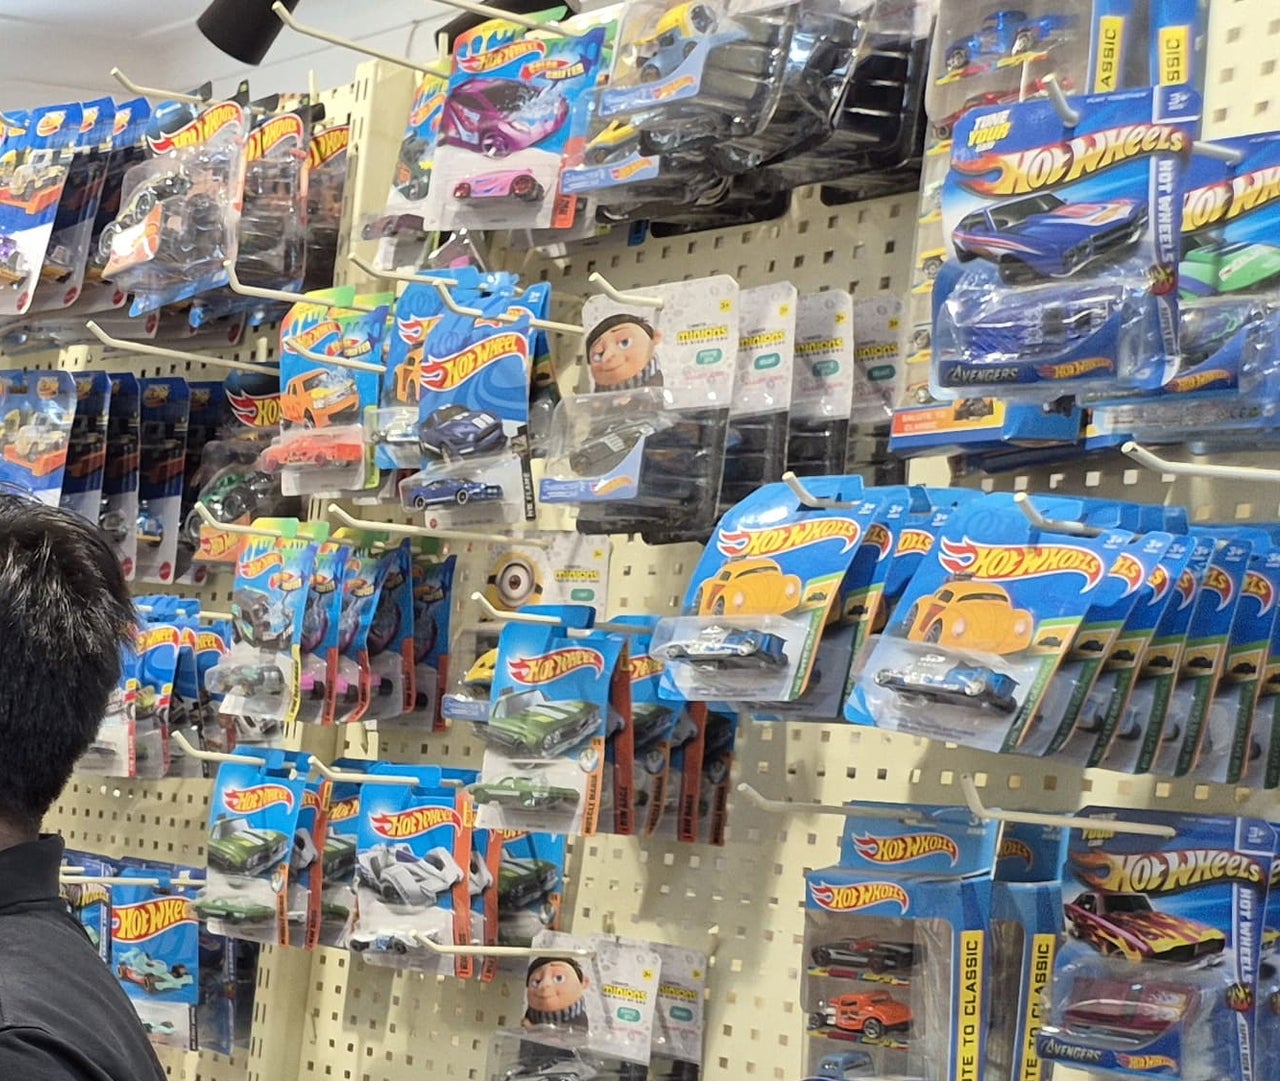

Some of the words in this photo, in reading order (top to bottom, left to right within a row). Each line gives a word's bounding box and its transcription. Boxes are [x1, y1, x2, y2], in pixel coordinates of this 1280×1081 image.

[1157, 159, 1175, 195] HOT
[1157, 198, 1175, 263] WHEELS
[447, 355, 476, 386] HOT
[747, 527, 789, 557] HOT
[789, 518, 858, 548] WHEELS
[975, 548, 1025, 577] HOT
[1025, 547, 1100, 575] WHEELS
[876, 837, 905, 861] HOT
[904, 834, 954, 857] WHEELS
[831, 886, 859, 908] HOT
[859, 882, 905, 903] WHEELS
[1239, 888, 1251, 922] HOT
[119, 907, 149, 939] HOT
[1239, 923, 1253, 984] WHEELS
[964, 940, 979, 1016] CLASSIC
[963, 1023, 976, 1045] TO
[1044, 1039, 1102, 1062] AVENGERS
